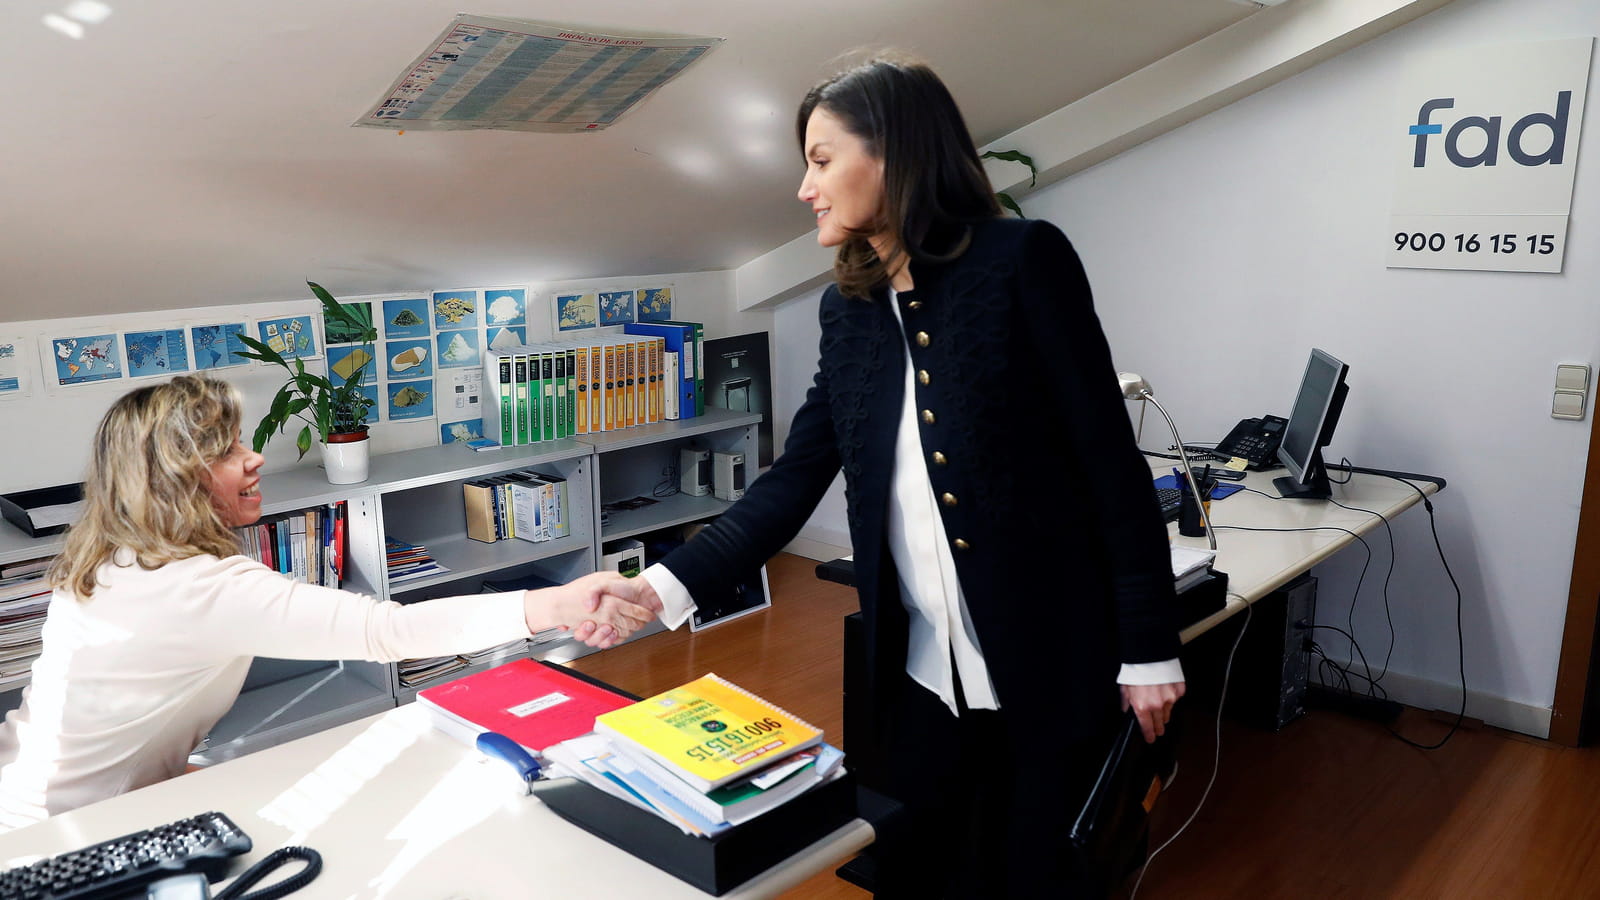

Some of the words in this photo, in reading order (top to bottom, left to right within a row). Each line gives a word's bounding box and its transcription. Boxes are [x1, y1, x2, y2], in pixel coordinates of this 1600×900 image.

[558, 32, 598, 41] DROGAS
[1408, 90, 1572, 169] fad
[1394, 232, 1446, 252] 900
[1454, 233, 1481, 253] 16
[1490, 234, 1517, 254] 15
[1526, 234, 1555, 255] 15
[744, 717, 782, 736] 900
[724, 729, 752, 743] 16
[705, 737, 733, 752] 15
[686, 745, 714, 761] 15
